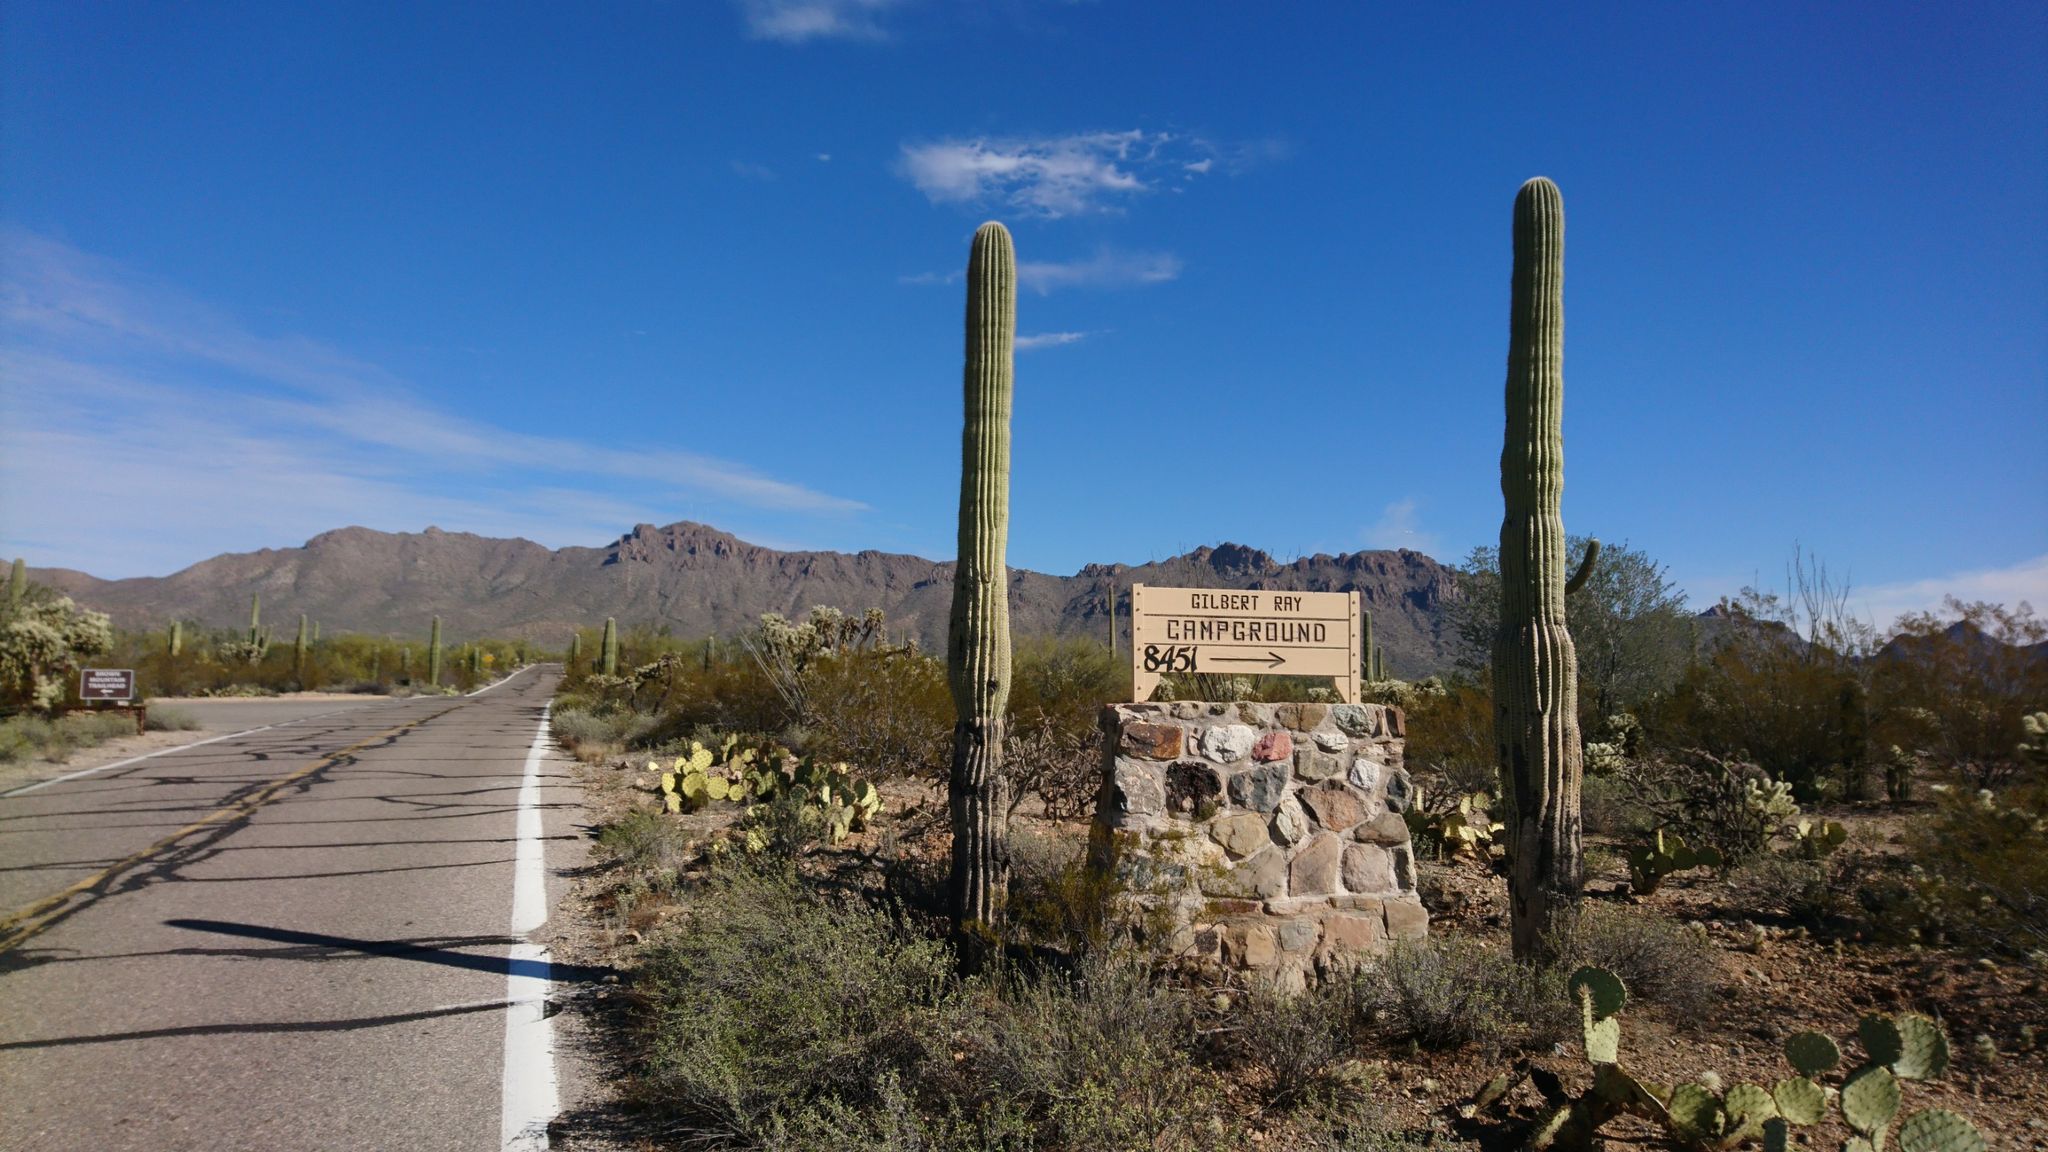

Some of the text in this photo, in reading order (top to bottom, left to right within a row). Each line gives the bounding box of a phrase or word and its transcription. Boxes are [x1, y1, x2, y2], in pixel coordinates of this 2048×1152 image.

[1191, 593, 1302, 612] GILBERT RAY
[1167, 619, 1326, 643] CAMPGROUND
[1144, 644, 1198, 673] 8451
